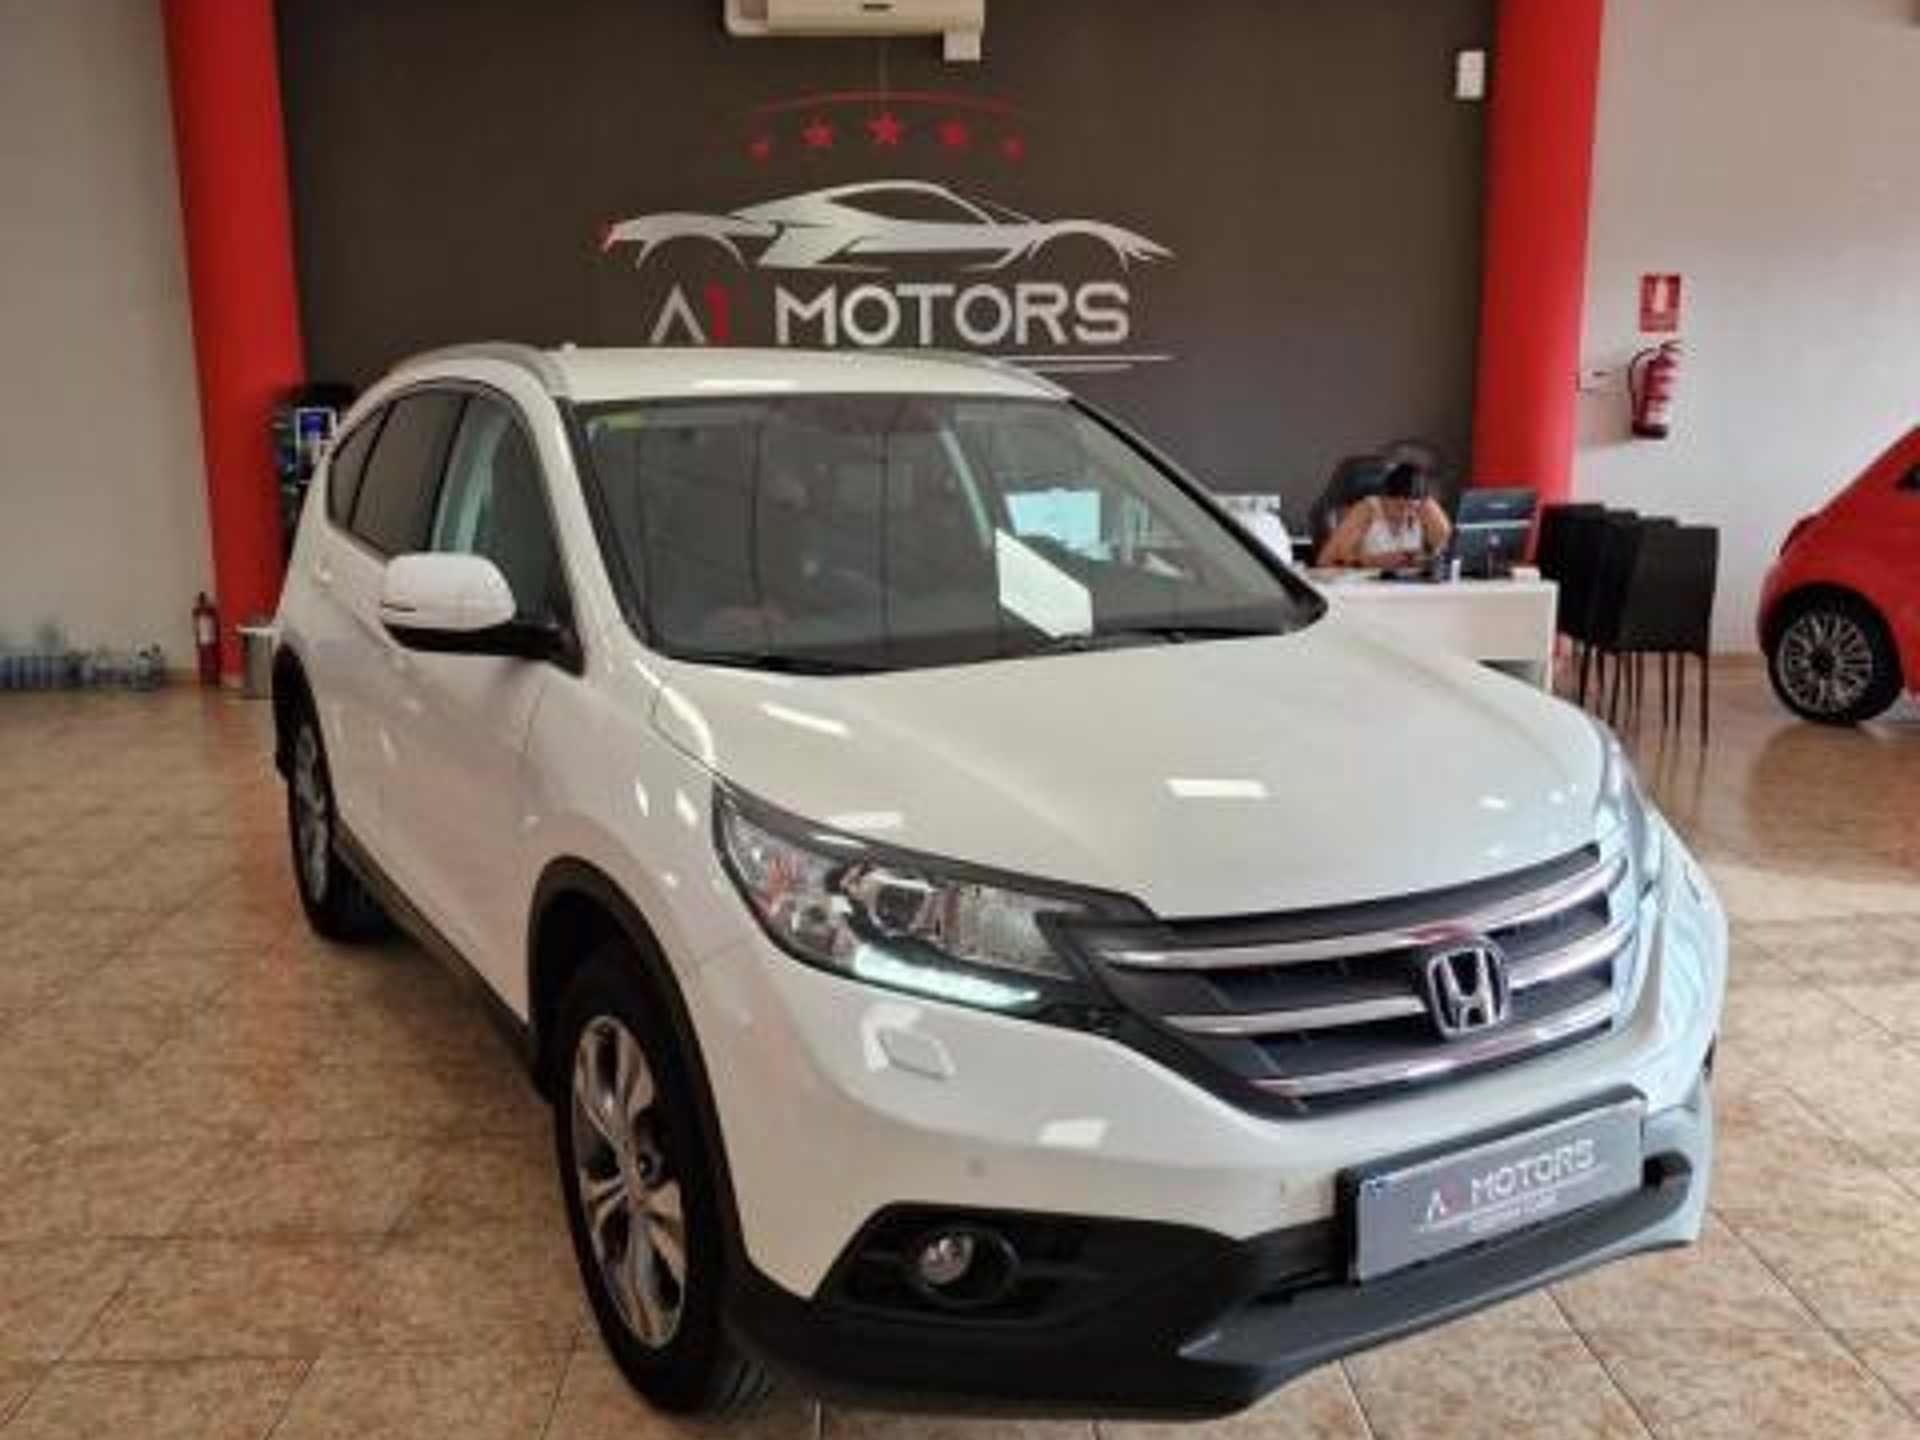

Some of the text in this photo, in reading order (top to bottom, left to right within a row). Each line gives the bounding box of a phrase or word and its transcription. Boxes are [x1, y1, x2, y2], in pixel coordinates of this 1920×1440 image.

[650, 282, 1130, 346] A1 MOTORS
[1470, 1138, 1595, 1206] MOTORS
